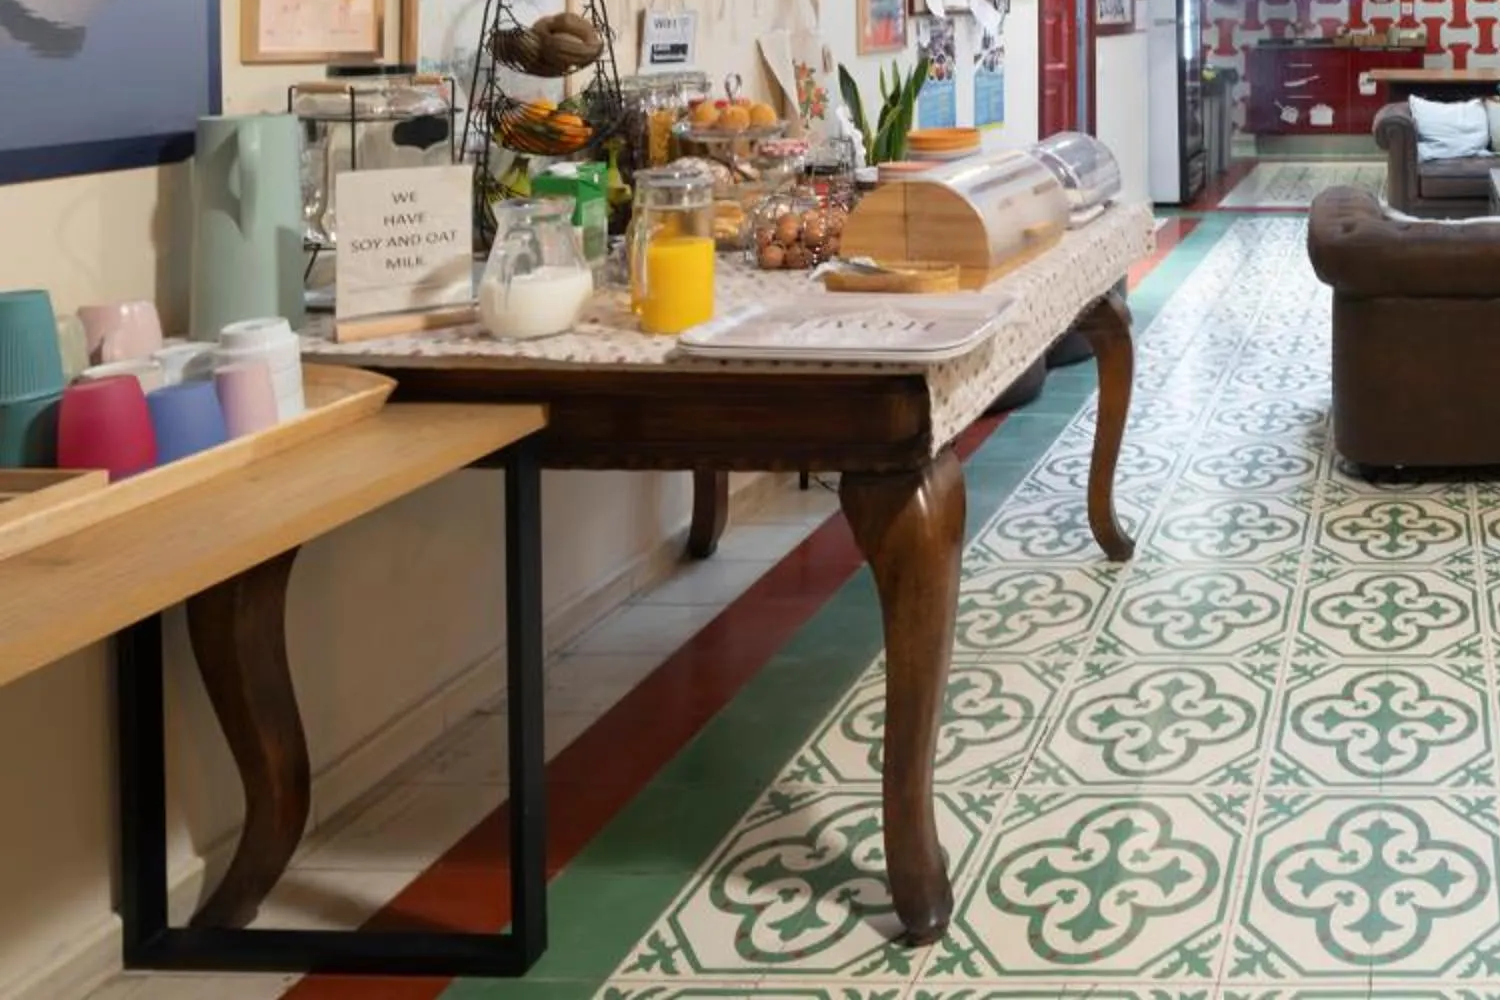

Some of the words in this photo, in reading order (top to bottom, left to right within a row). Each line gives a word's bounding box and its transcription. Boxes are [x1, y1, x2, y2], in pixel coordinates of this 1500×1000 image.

[391, 191, 417, 204] WE
[383, 212, 427, 227] HAVE
[351, 237, 380, 254] SOY
[387, 233, 420, 249] AND
[425, 230, 457, 245] OAT
[385, 255, 424, 270] MILK
